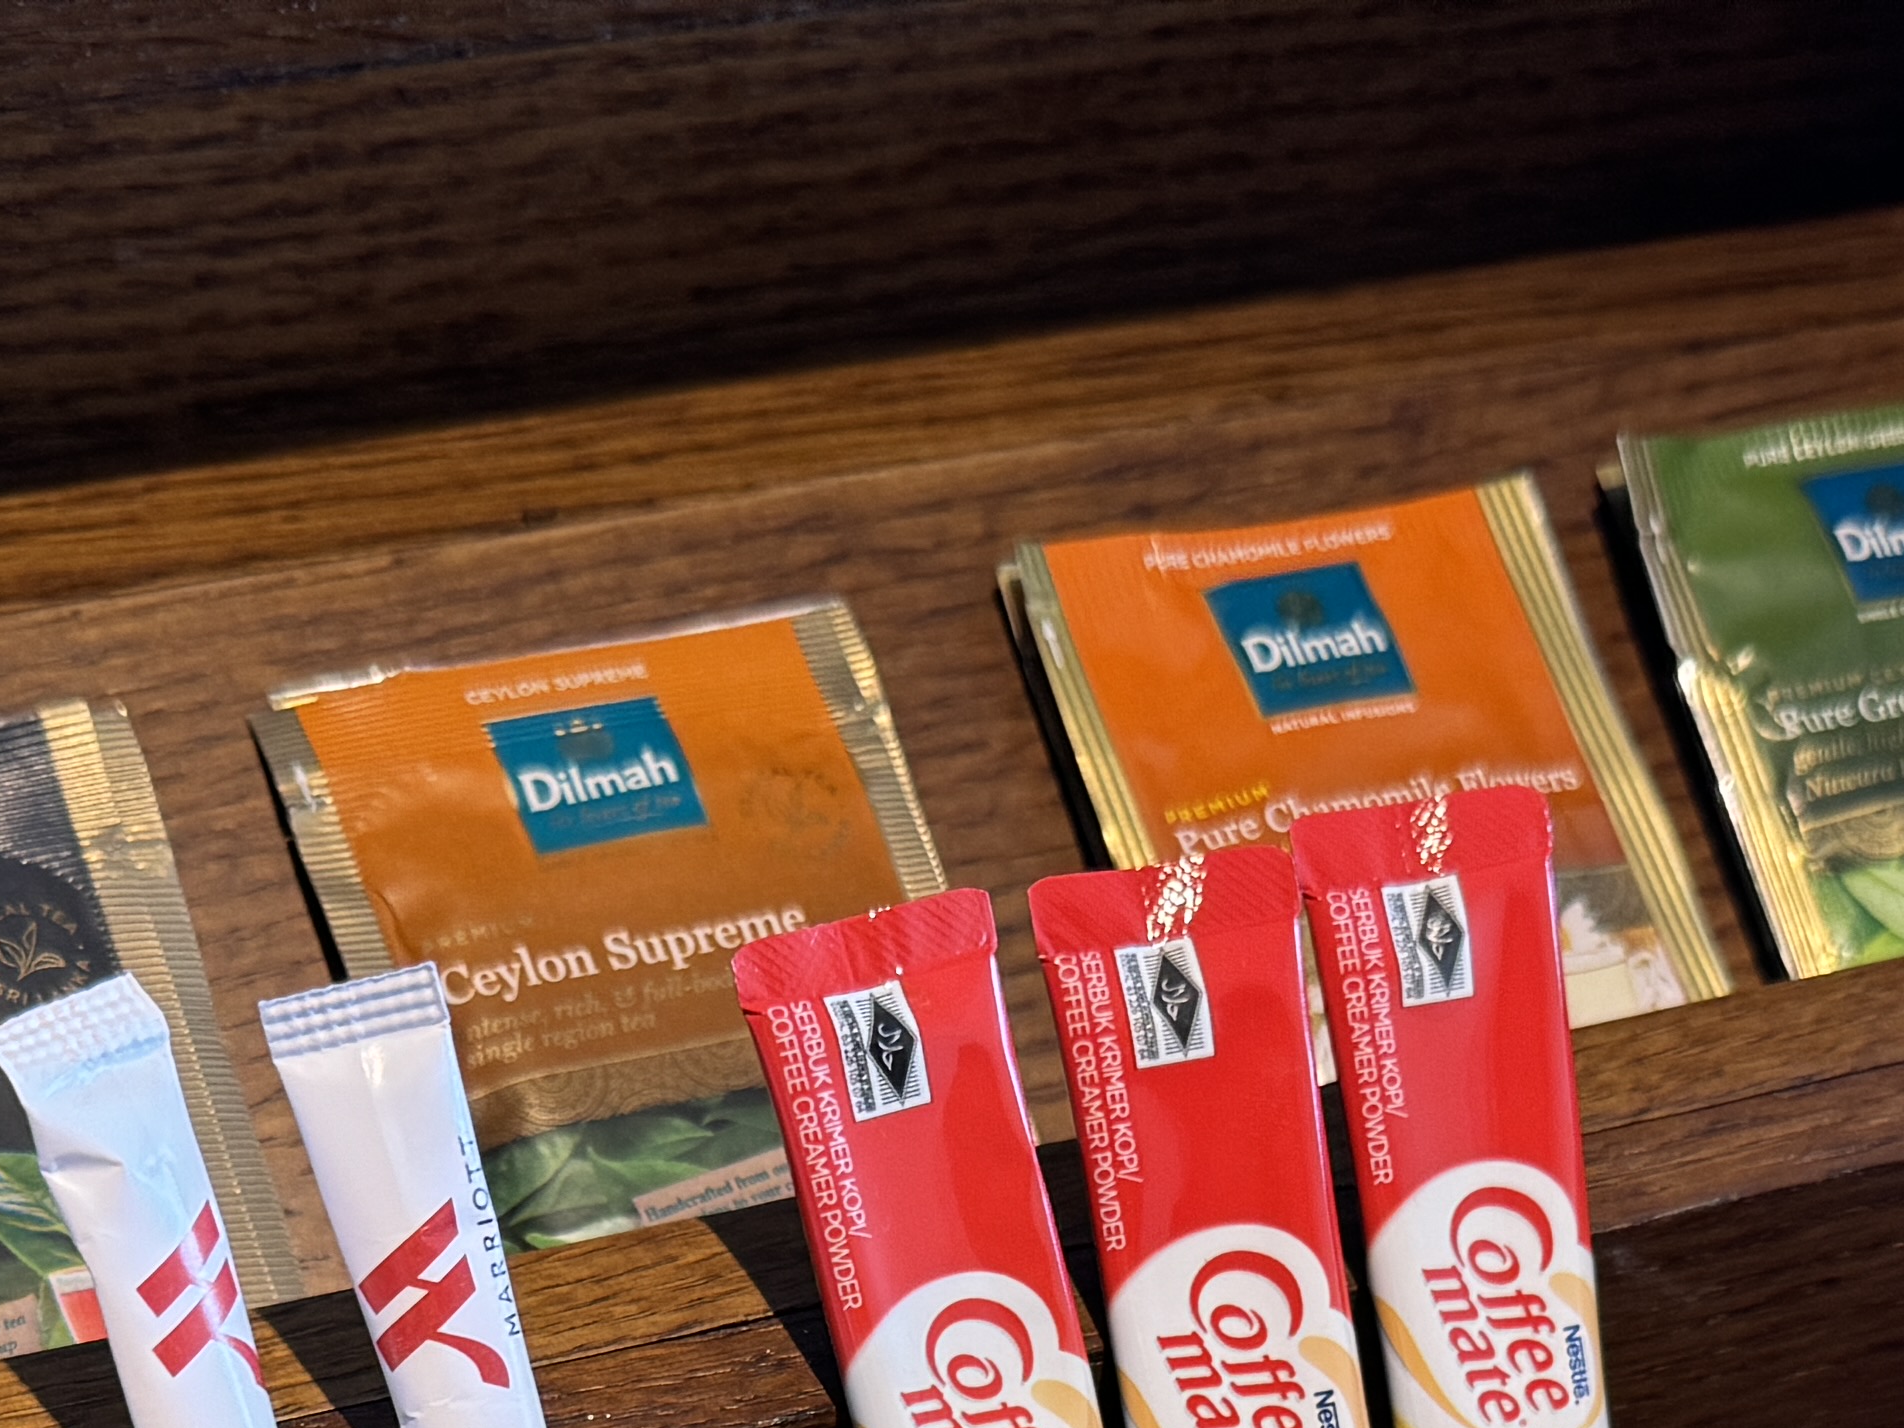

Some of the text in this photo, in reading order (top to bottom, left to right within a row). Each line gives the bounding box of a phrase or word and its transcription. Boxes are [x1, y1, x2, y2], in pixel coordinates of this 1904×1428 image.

[1303, 525, 1393, 554] FLOWERS
[465, 660, 649, 707] CEYLON SUPREME
[1241, 613, 1387, 674] Dilmah
[518, 742, 680, 813] Dilmah
[1773, 702, 1858, 737] Pure
[1164, 783, 1271, 826] PREMIUM
[1174, 816, 1264, 857] Pure
[38, 903, 78, 937] TEA
[440, 944, 599, 1005] Ceylon
[603, 905, 807, 971] Supreme
[1079, 951, 1144, 1184] SERBUK KRIMER KOPI/
[1326, 891, 1394, 1187] COFFEE CREAMER POWDER
[1347, 887, 1409, 1120] SERBUK KRIMER KOPI/
[767, 1005, 863, 1312] COFFEE CREAMER POWDER
[790, 1000, 834, 1089] SERBUK
[816, 1090, 853, 1177] KRIMER
[839, 1175, 872, 1239] KOPI/
[1056, 954, 1126, 1252] COFFEE CREAMER POWDER
[457, 1134, 521, 1337] MARRIOTT
[1449, 1186, 1570, 1413] Coffee
[1421, 1264, 1522, 1426] mate
